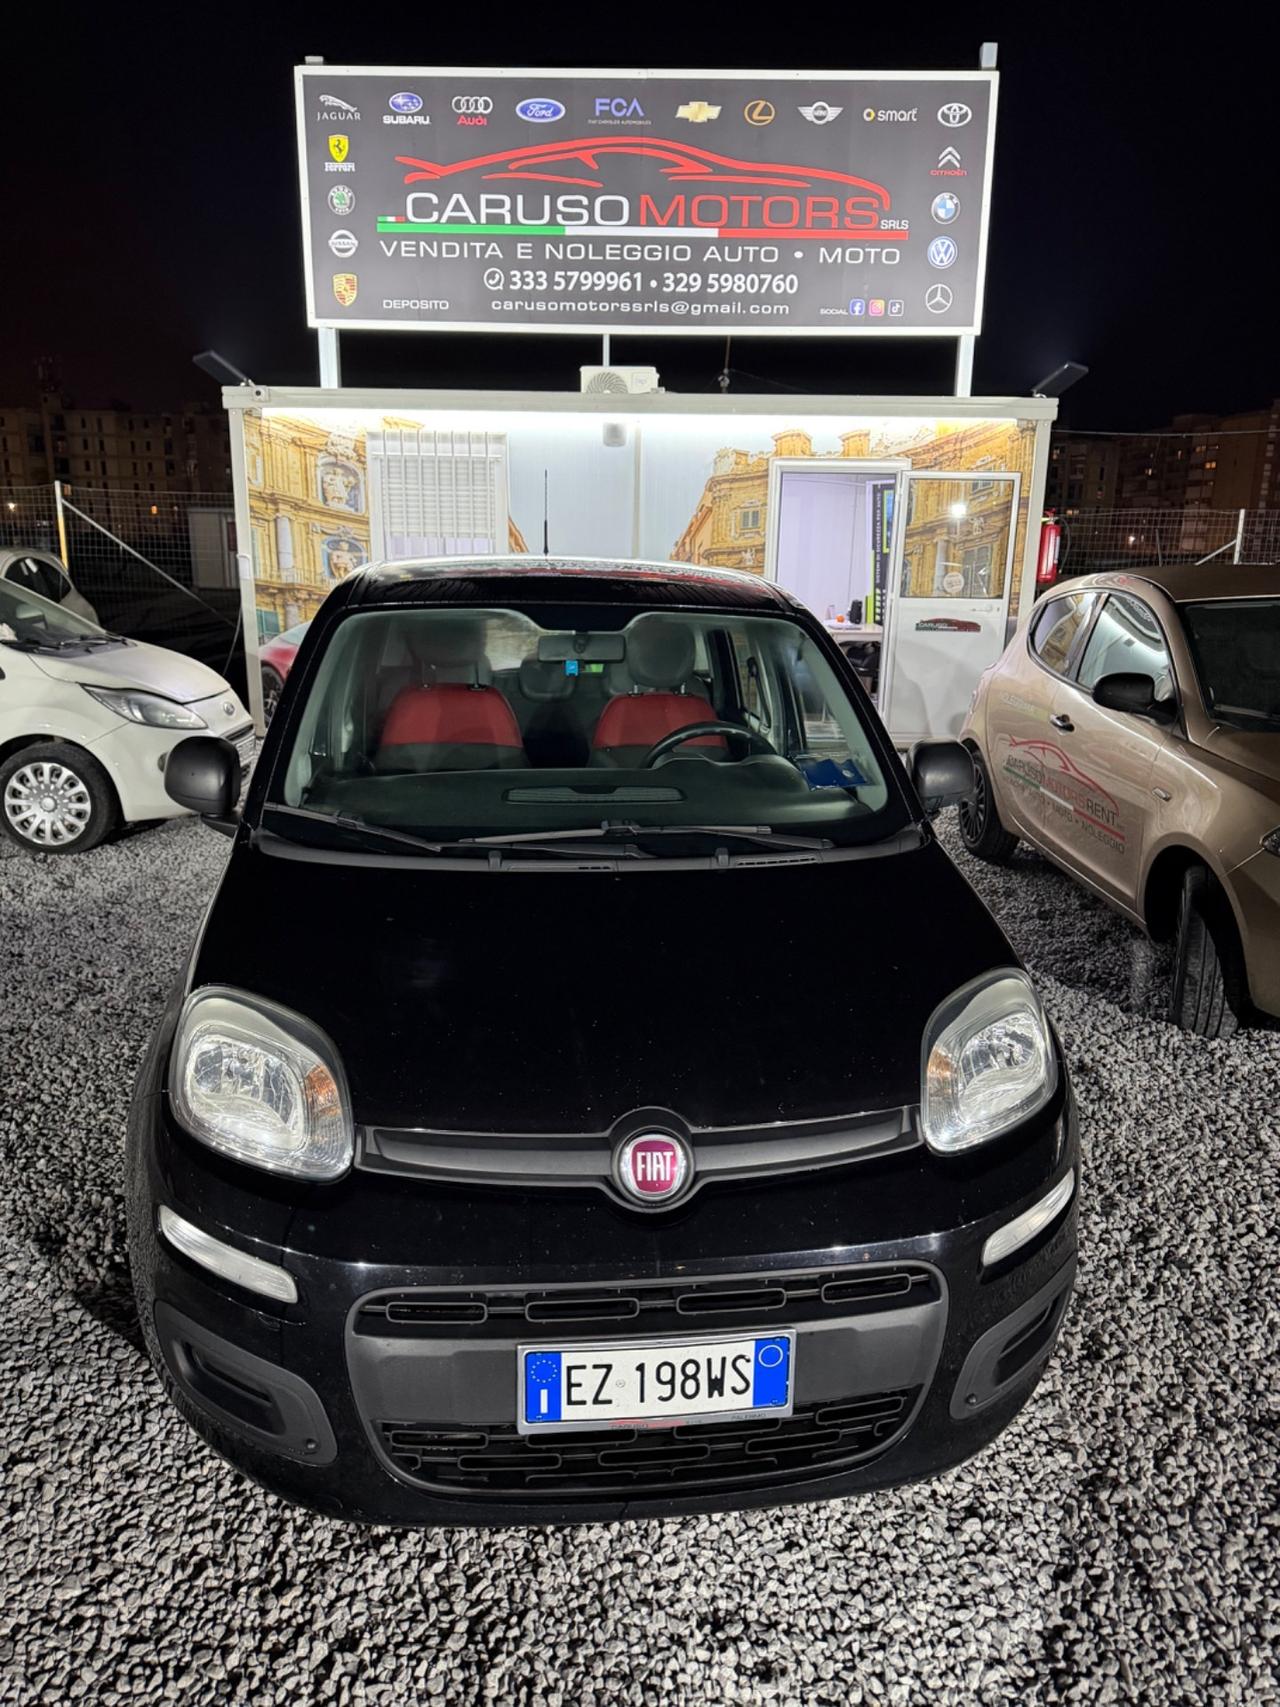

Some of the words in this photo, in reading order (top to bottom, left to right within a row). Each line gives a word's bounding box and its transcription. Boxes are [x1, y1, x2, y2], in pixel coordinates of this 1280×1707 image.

[527, 103, 553, 117] Ford
[595, 97, 645, 117] FCA
[317, 111, 361, 121] JAGUAR
[382, 115, 430, 125] SUBARU
[457, 113, 488, 126] Audi
[877, 108, 918, 122] smart
[324, 162, 356, 172] Ferrari
[405, 192, 630, 226] CARUSO
[639, 194, 880, 229] MOTORS
[880, 220, 909, 230] SRLS
[380, 241, 503, 259] VENDITA
[516, 243, 533, 260] E
[545, 243, 692, 262] NOLEGGIO
[703, 246, 779, 263] AUTO
[819, 247, 901, 265] MOTO
[509, 270, 548, 291] 333
[553, 271, 642, 292] 5799961
[662, 272, 702, 293] 329
[706, 273, 799, 294] 5980760
[383, 300, 450, 310] DEPOSITO
[492, 300, 790, 316] carusomotorssrls@gmail.com
[820, 308, 848, 316] SOCIAL
[1087, 798, 1116, 826] RENT
[637, 1152, 673, 1182] FIAT
[565, 1363, 614, 1406] EZ
[635, 1354, 751, 1404] 198WS
